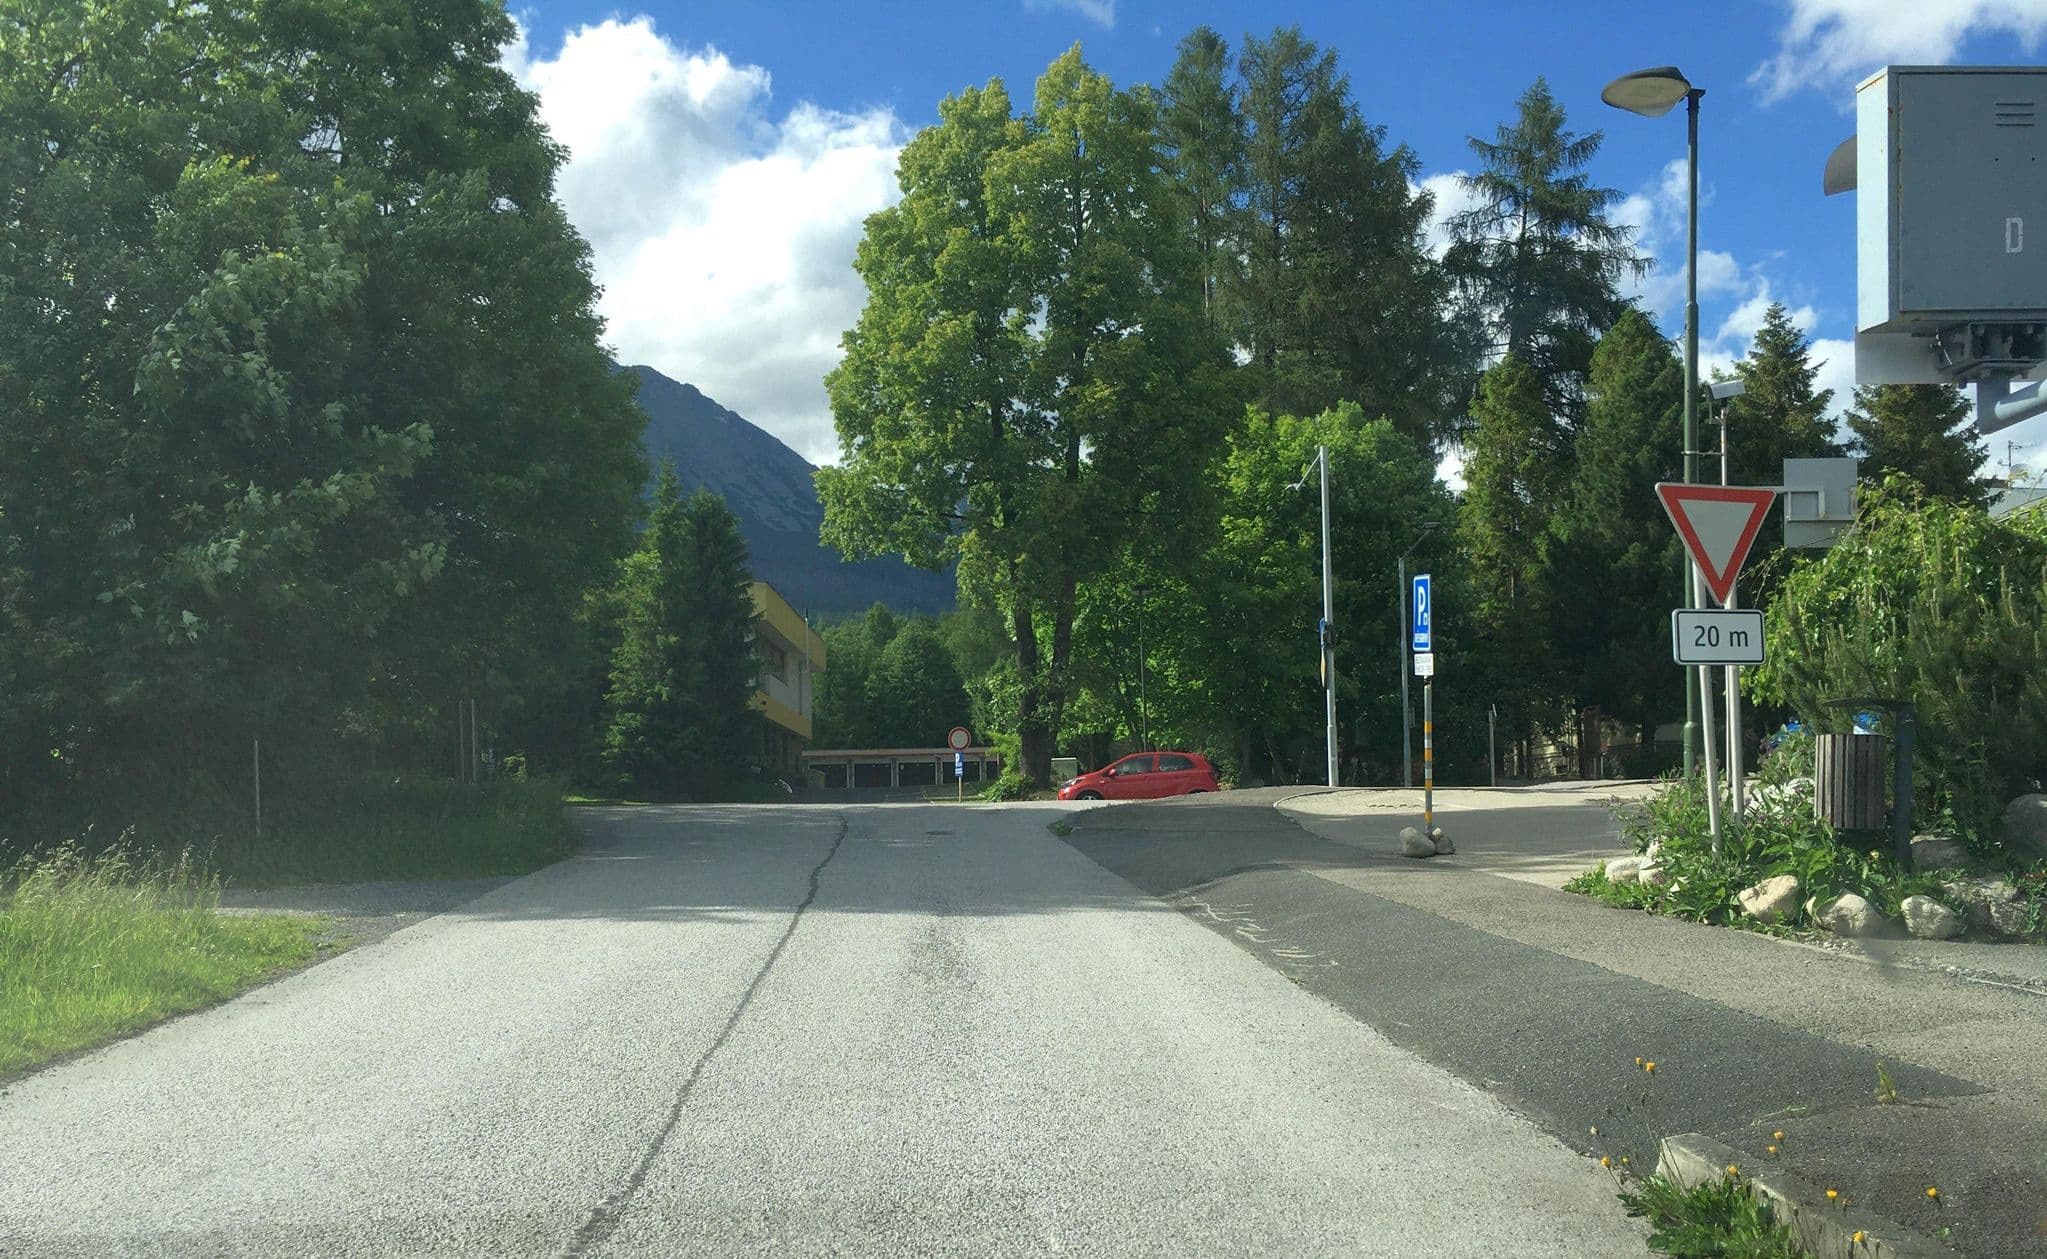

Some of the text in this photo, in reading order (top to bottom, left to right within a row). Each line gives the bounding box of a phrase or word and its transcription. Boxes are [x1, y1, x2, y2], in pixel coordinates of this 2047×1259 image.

[1418, 586, 1426, 626] P
[1694, 625, 1749, 647] 20 m
